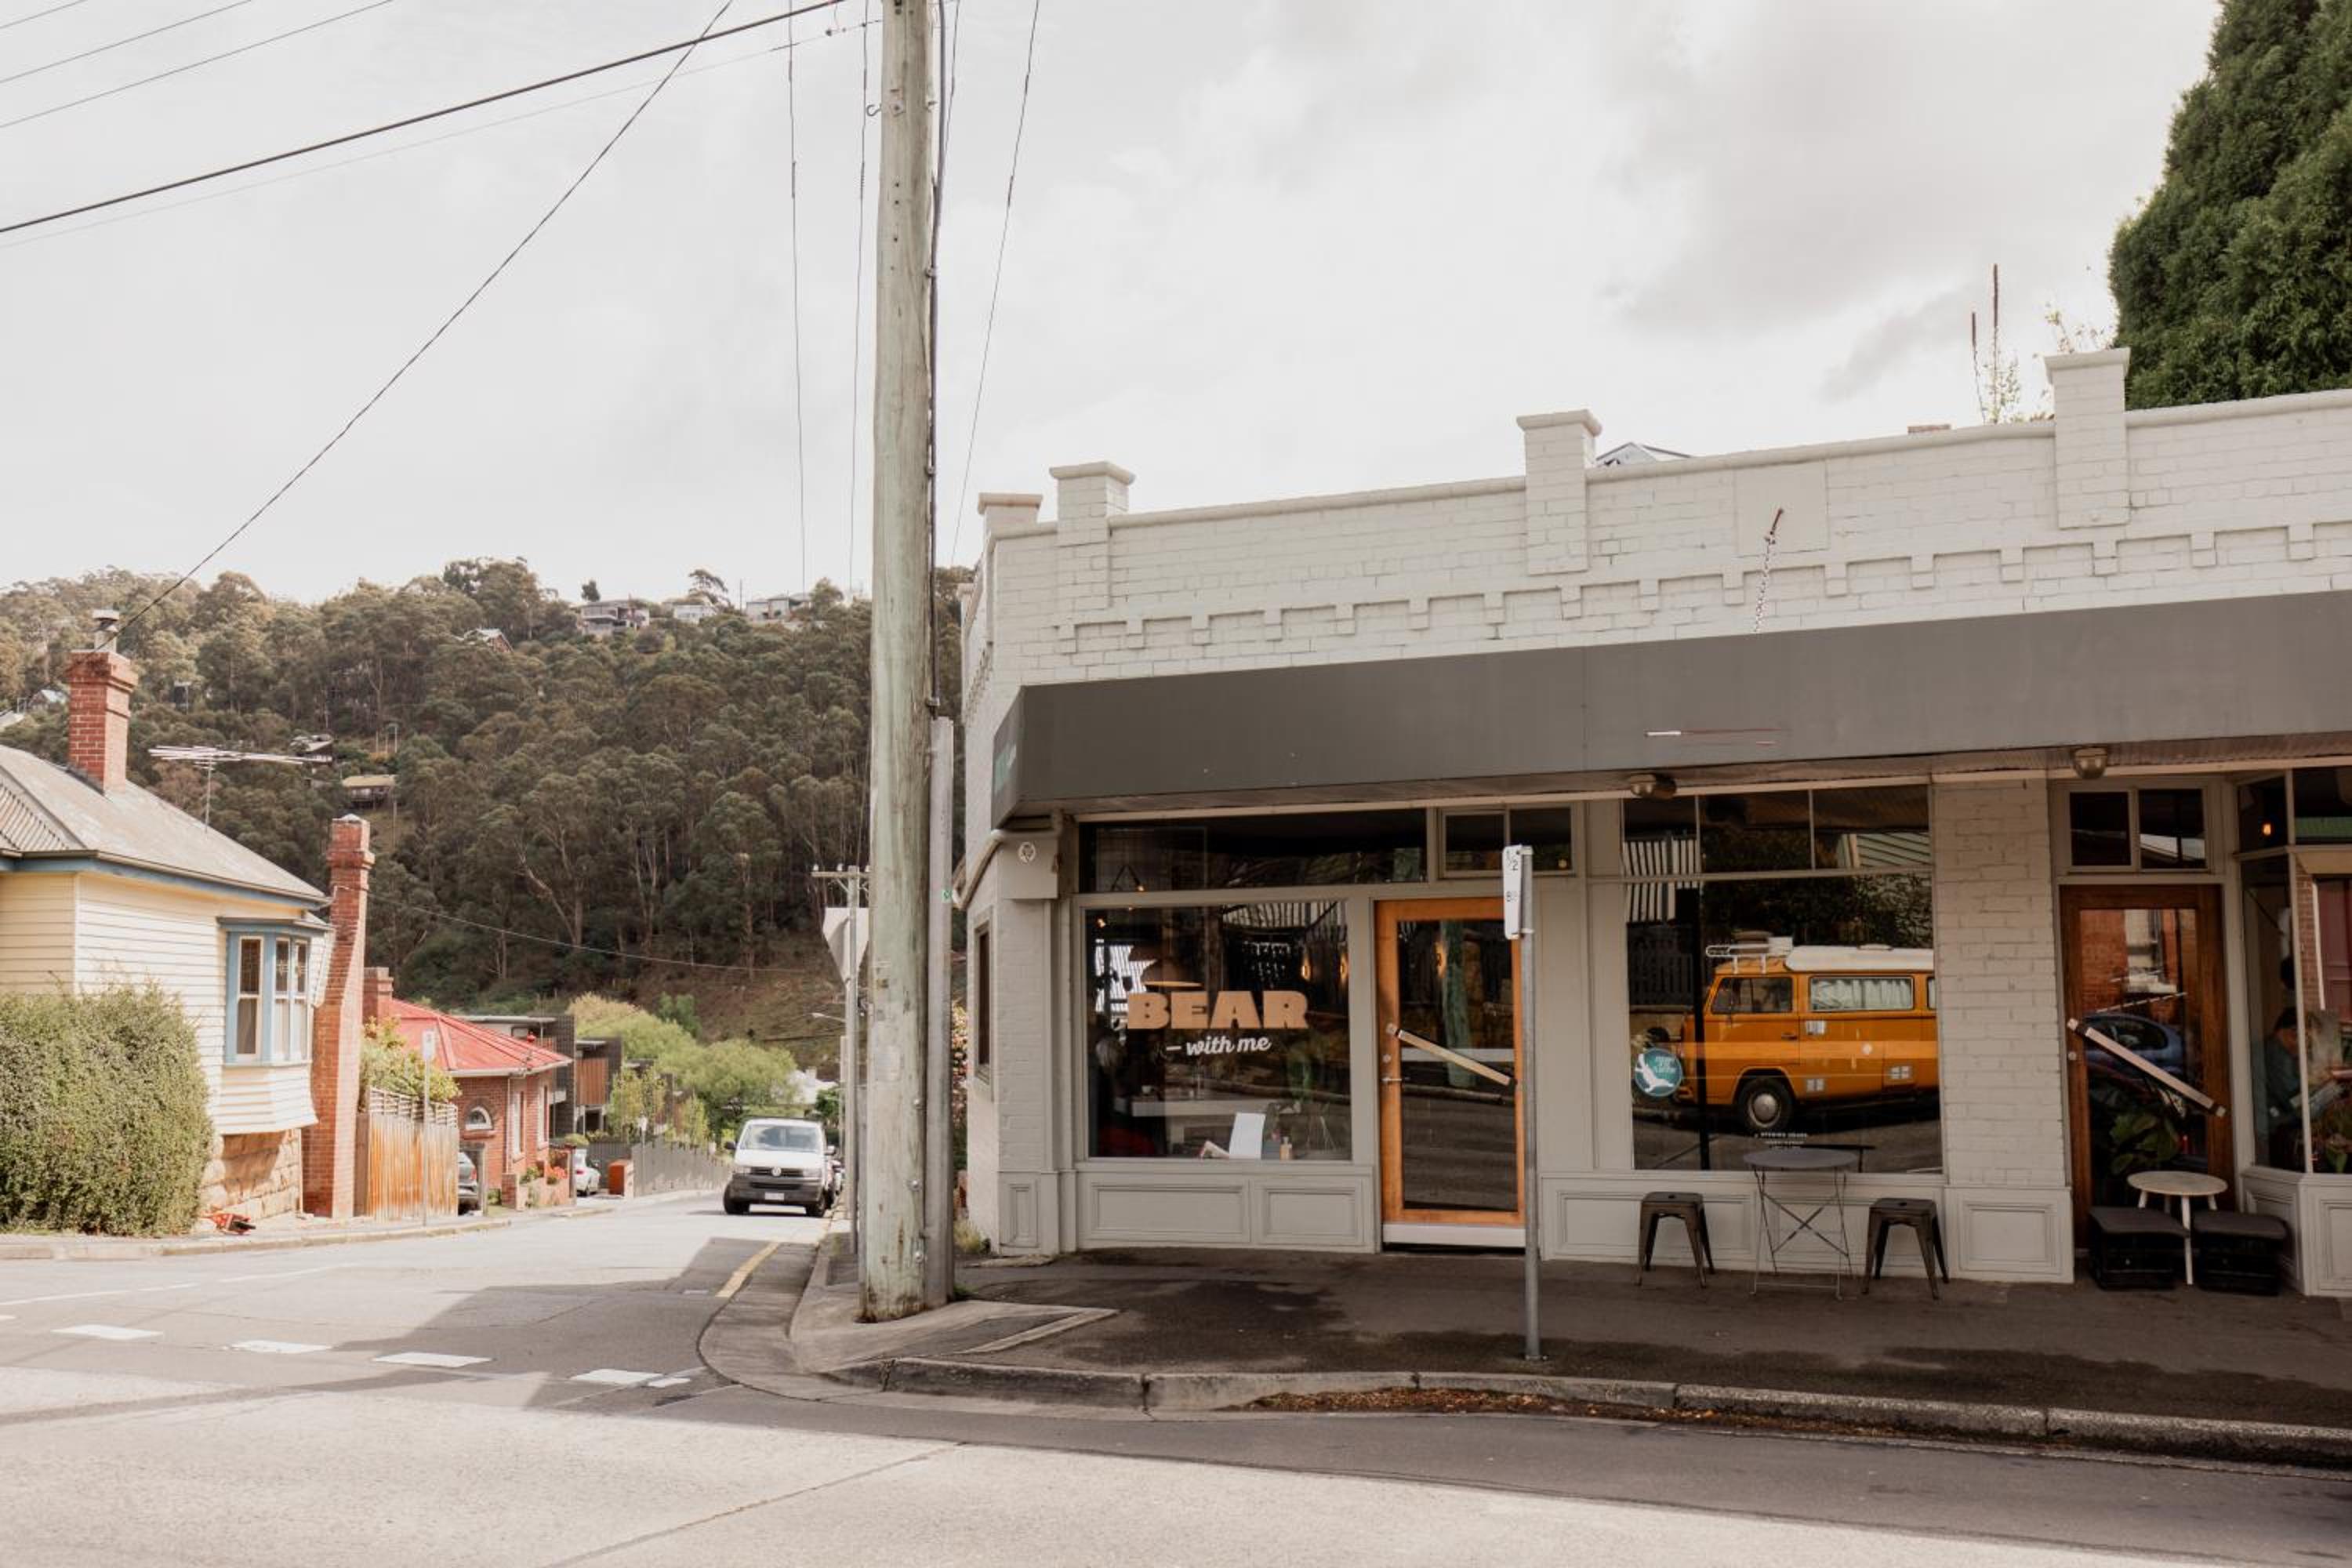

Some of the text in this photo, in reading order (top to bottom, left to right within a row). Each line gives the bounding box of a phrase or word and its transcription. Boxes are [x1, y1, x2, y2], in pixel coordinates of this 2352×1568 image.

[1127, 990, 1309, 1029] BEAR
[1185, 1035, 1272, 1056] with me
